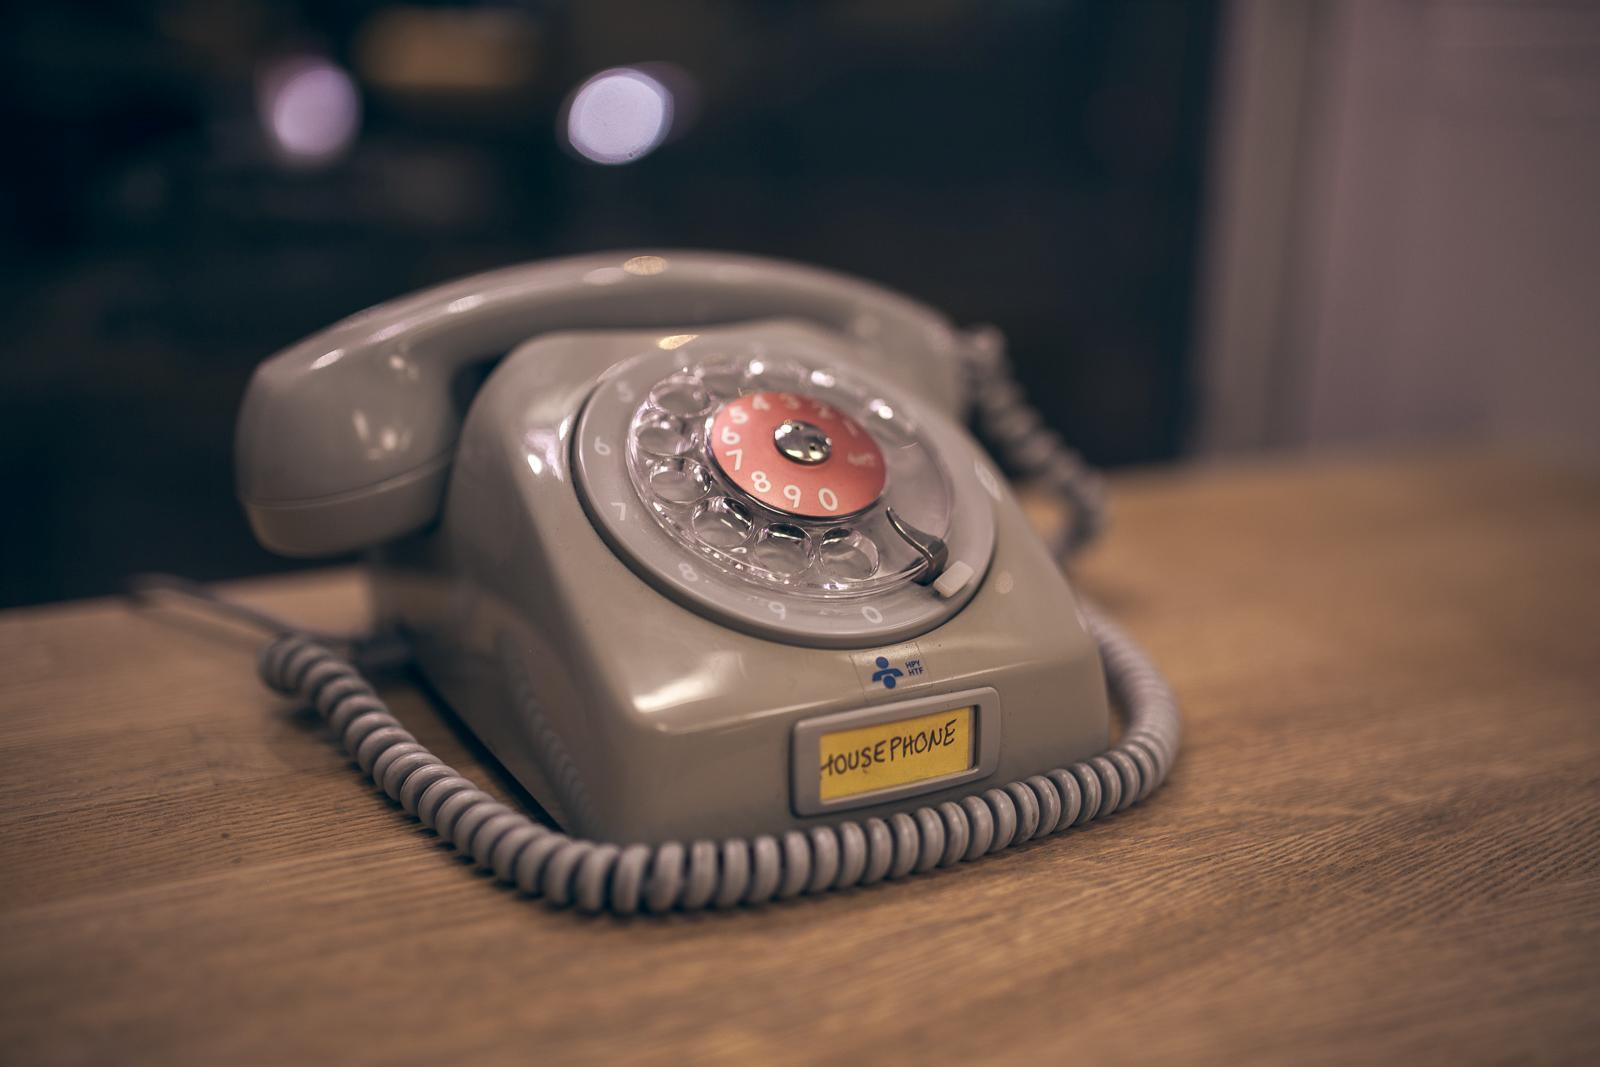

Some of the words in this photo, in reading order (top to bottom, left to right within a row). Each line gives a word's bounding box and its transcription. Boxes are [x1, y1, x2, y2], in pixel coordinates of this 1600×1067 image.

[752, 395, 771, 411] 4
[729, 406, 748, 424] 5
[594, 435, 611, 456] 6
[721, 426, 741, 445] 6
[725, 448, 743, 471] 7
[751, 470, 772, 493] 8
[783, 484, 802, 509] 9
[818, 487, 839, 511] 0
[611, 502, 626, 521] 7
[678, 563, 699, 583] 8
[768, 601, 786, 621] 9
[861, 605, 884, 624] 0
